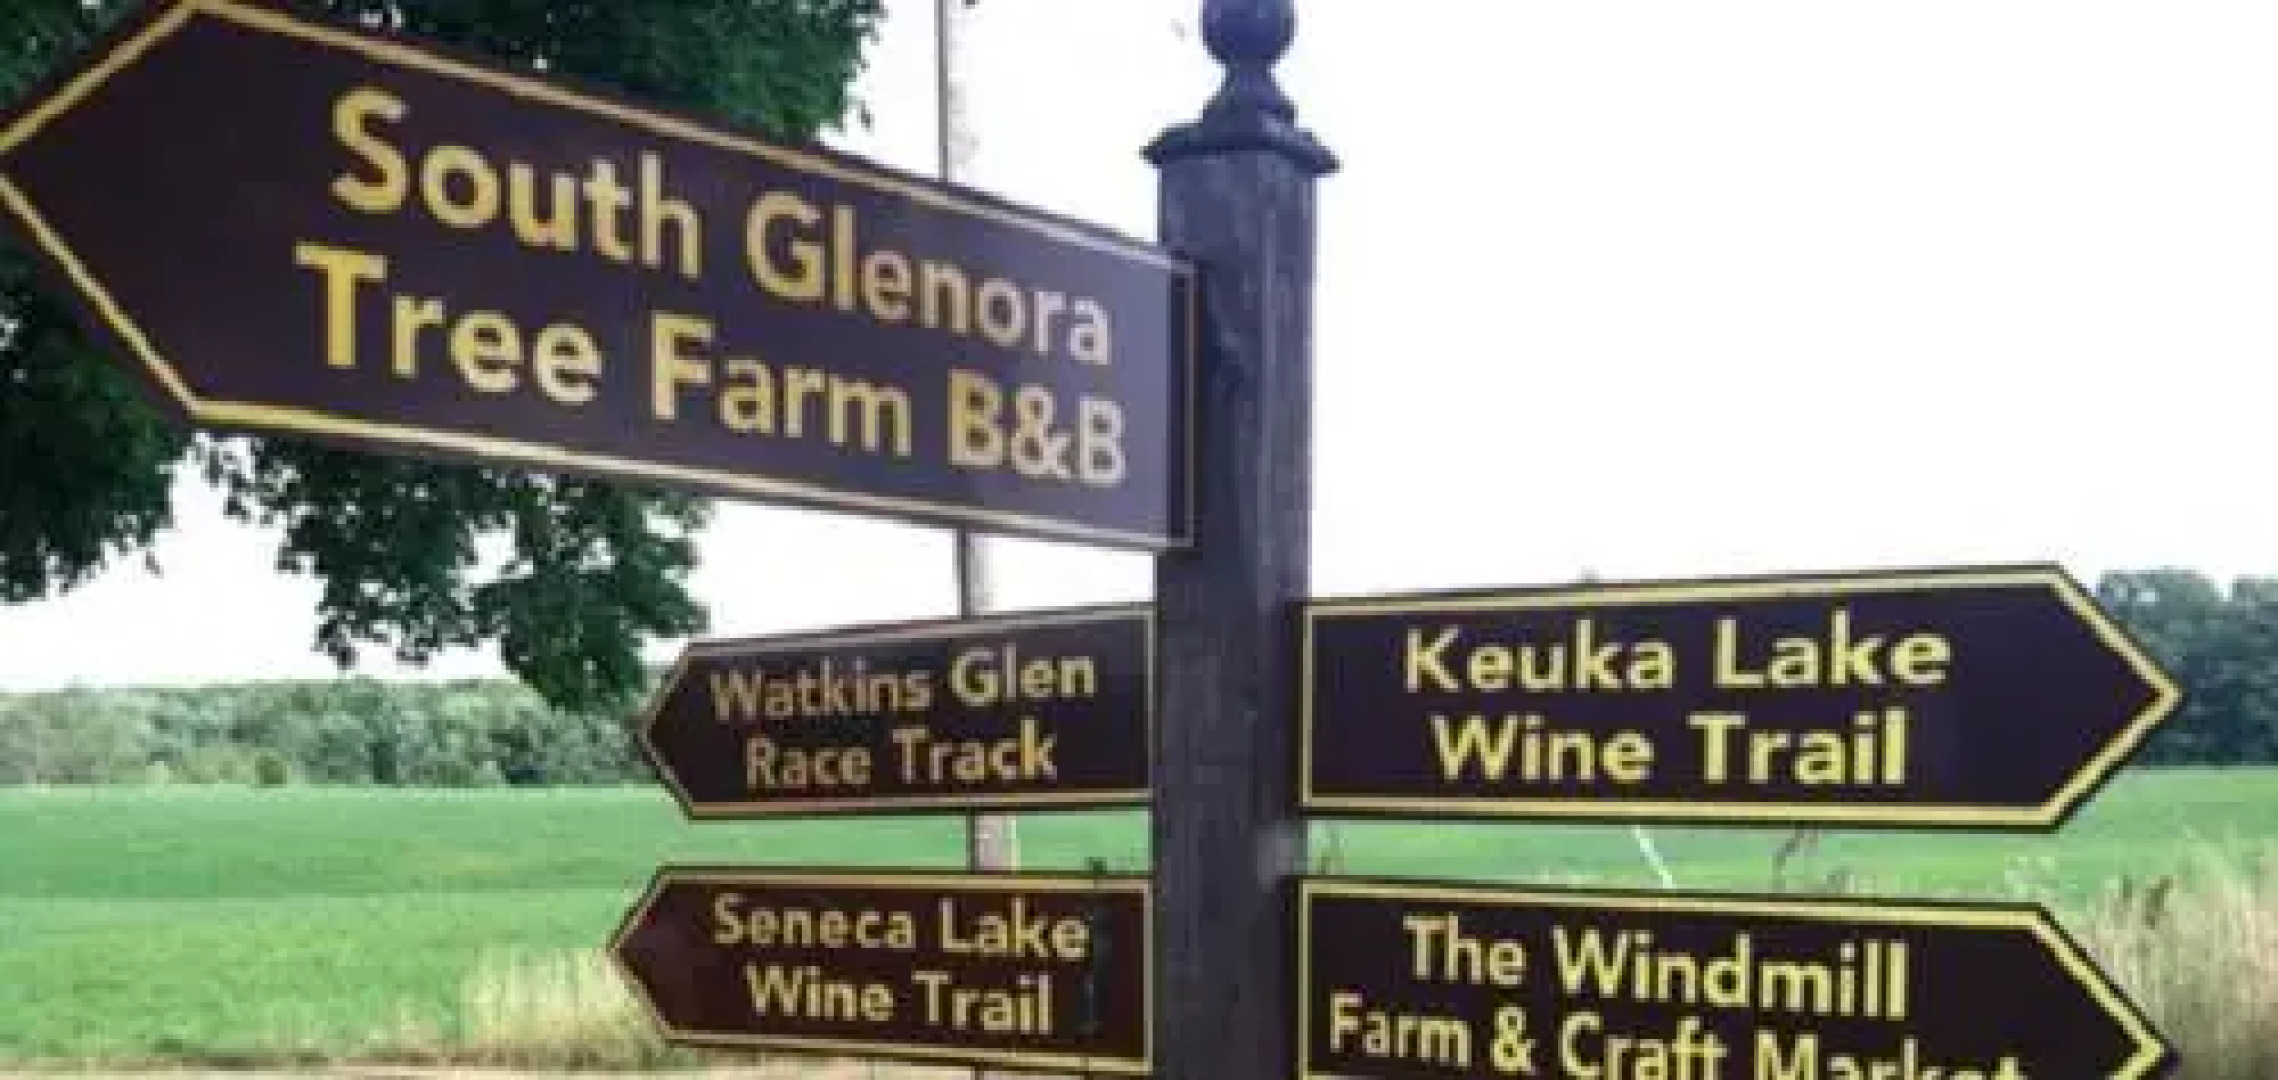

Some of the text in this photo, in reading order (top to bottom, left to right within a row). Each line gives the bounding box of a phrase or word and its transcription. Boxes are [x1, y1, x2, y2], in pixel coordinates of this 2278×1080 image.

[331, 85, 1111, 366] South Glenora
[293, 239, 1127, 488] Tree Farm B&B
[709, 641, 1097, 721] Watkins Glen
[1404, 610, 1952, 693] Keuka Lake
[745, 718, 1058, 790] Race Track
[1430, 707, 1908, 786] Wine Trail
[712, 892, 1090, 960] Seneca Lake
[744, 964, 1054, 1035] Wine Trail
[1403, 915, 1908, 1022] The Windmill
[1330, 992, 1471, 1068] Farm
[1490, 1006, 1537, 1075] &
[1559, 1012, 1728, 1080] Craft
